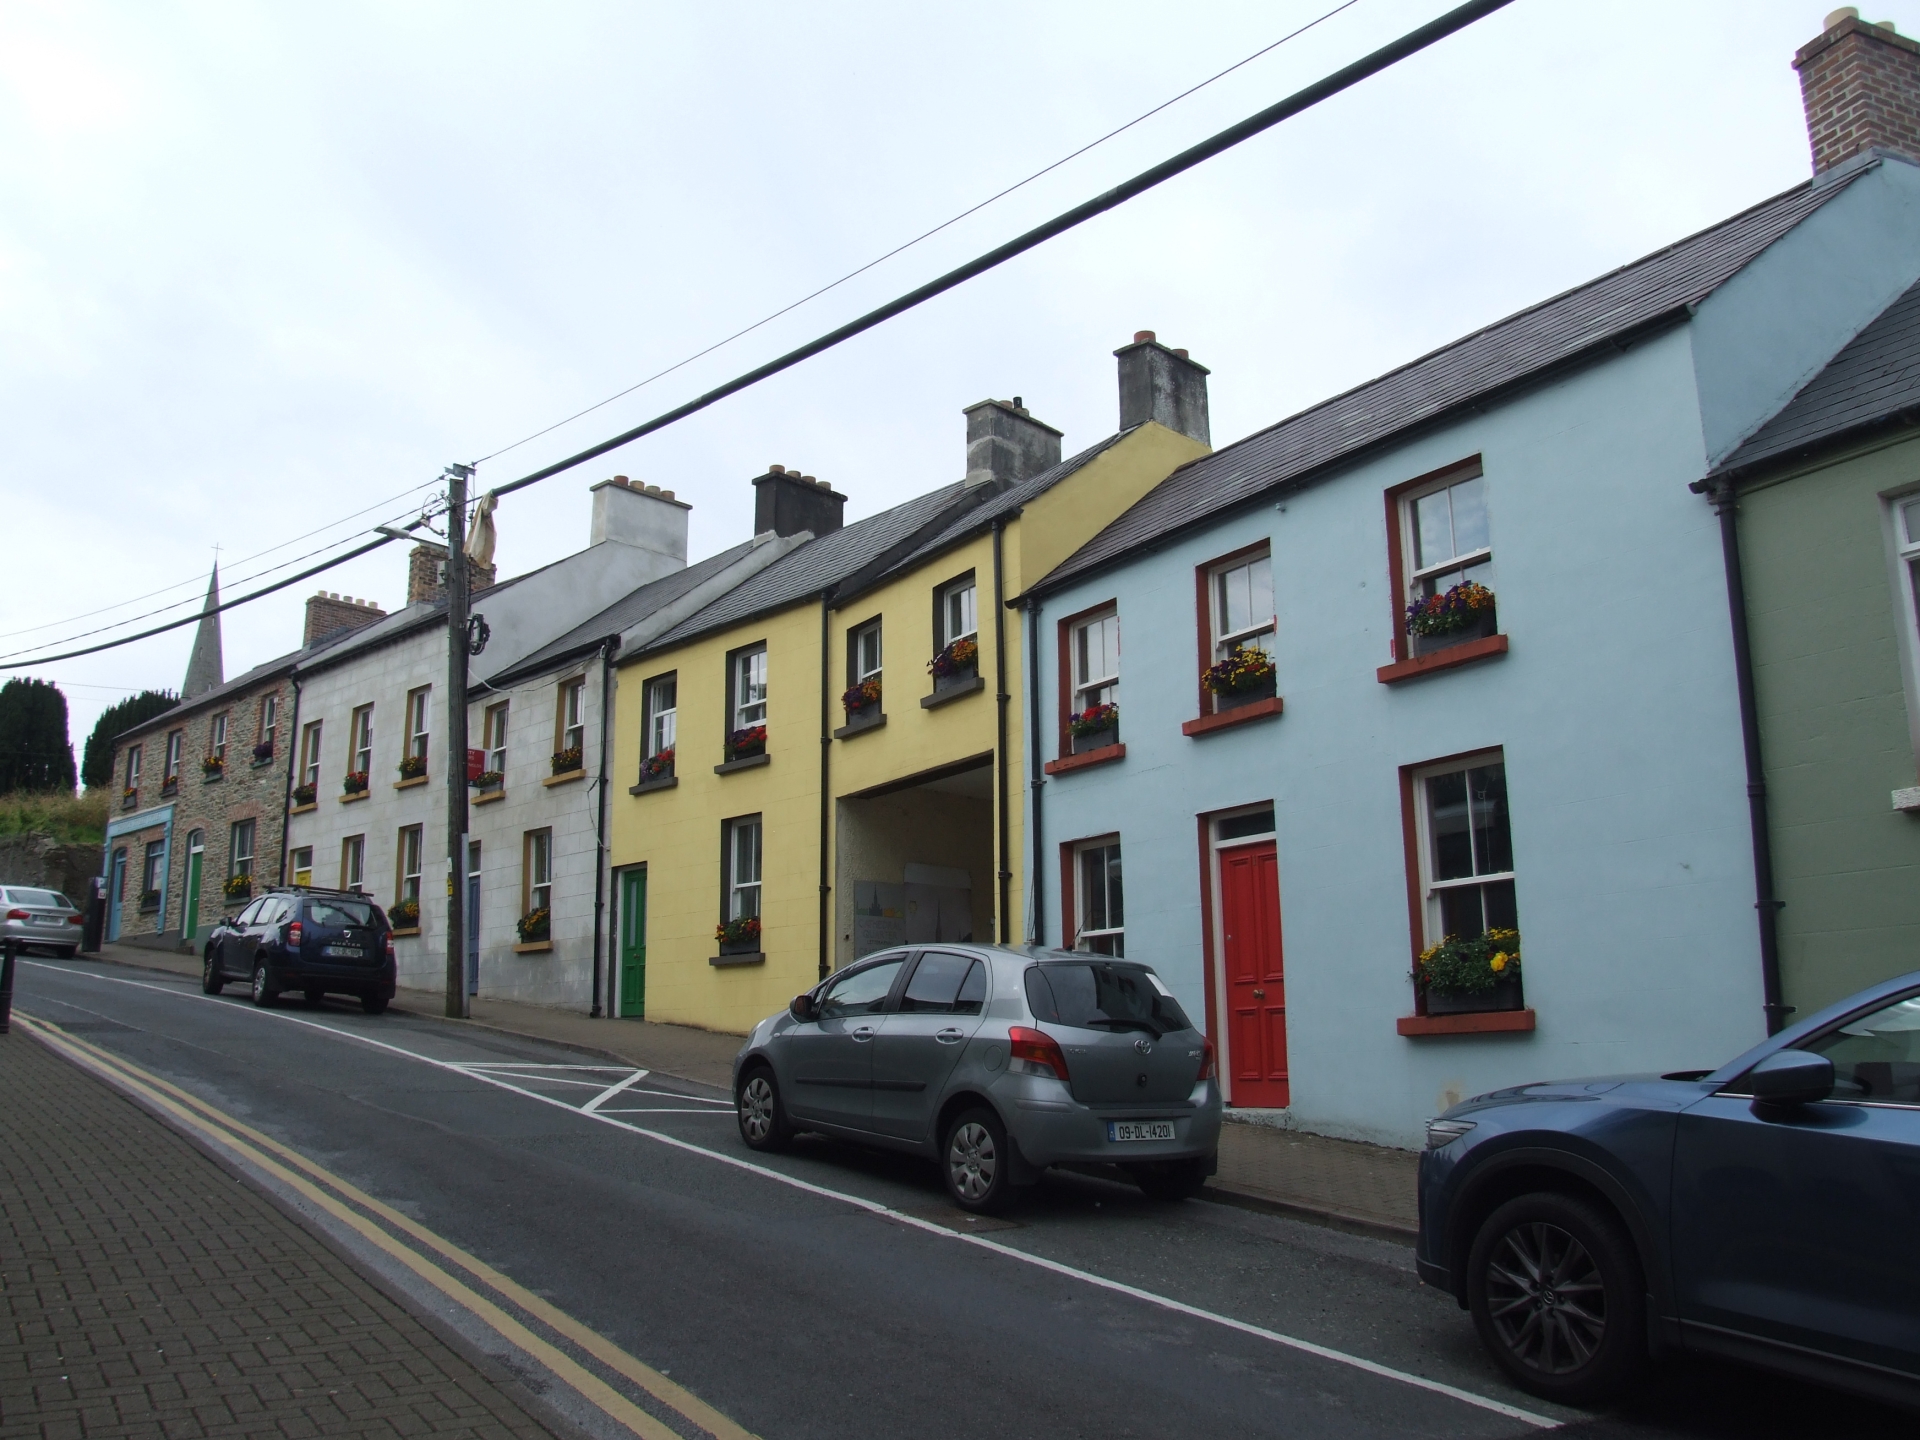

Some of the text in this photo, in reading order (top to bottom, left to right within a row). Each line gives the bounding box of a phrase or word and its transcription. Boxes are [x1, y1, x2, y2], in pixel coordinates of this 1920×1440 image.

[98, 878, 105, 887] P
[863, 930, 898, 940] QUARTER
[1119, 1125, 1171, 1139] 09-DL-14201
